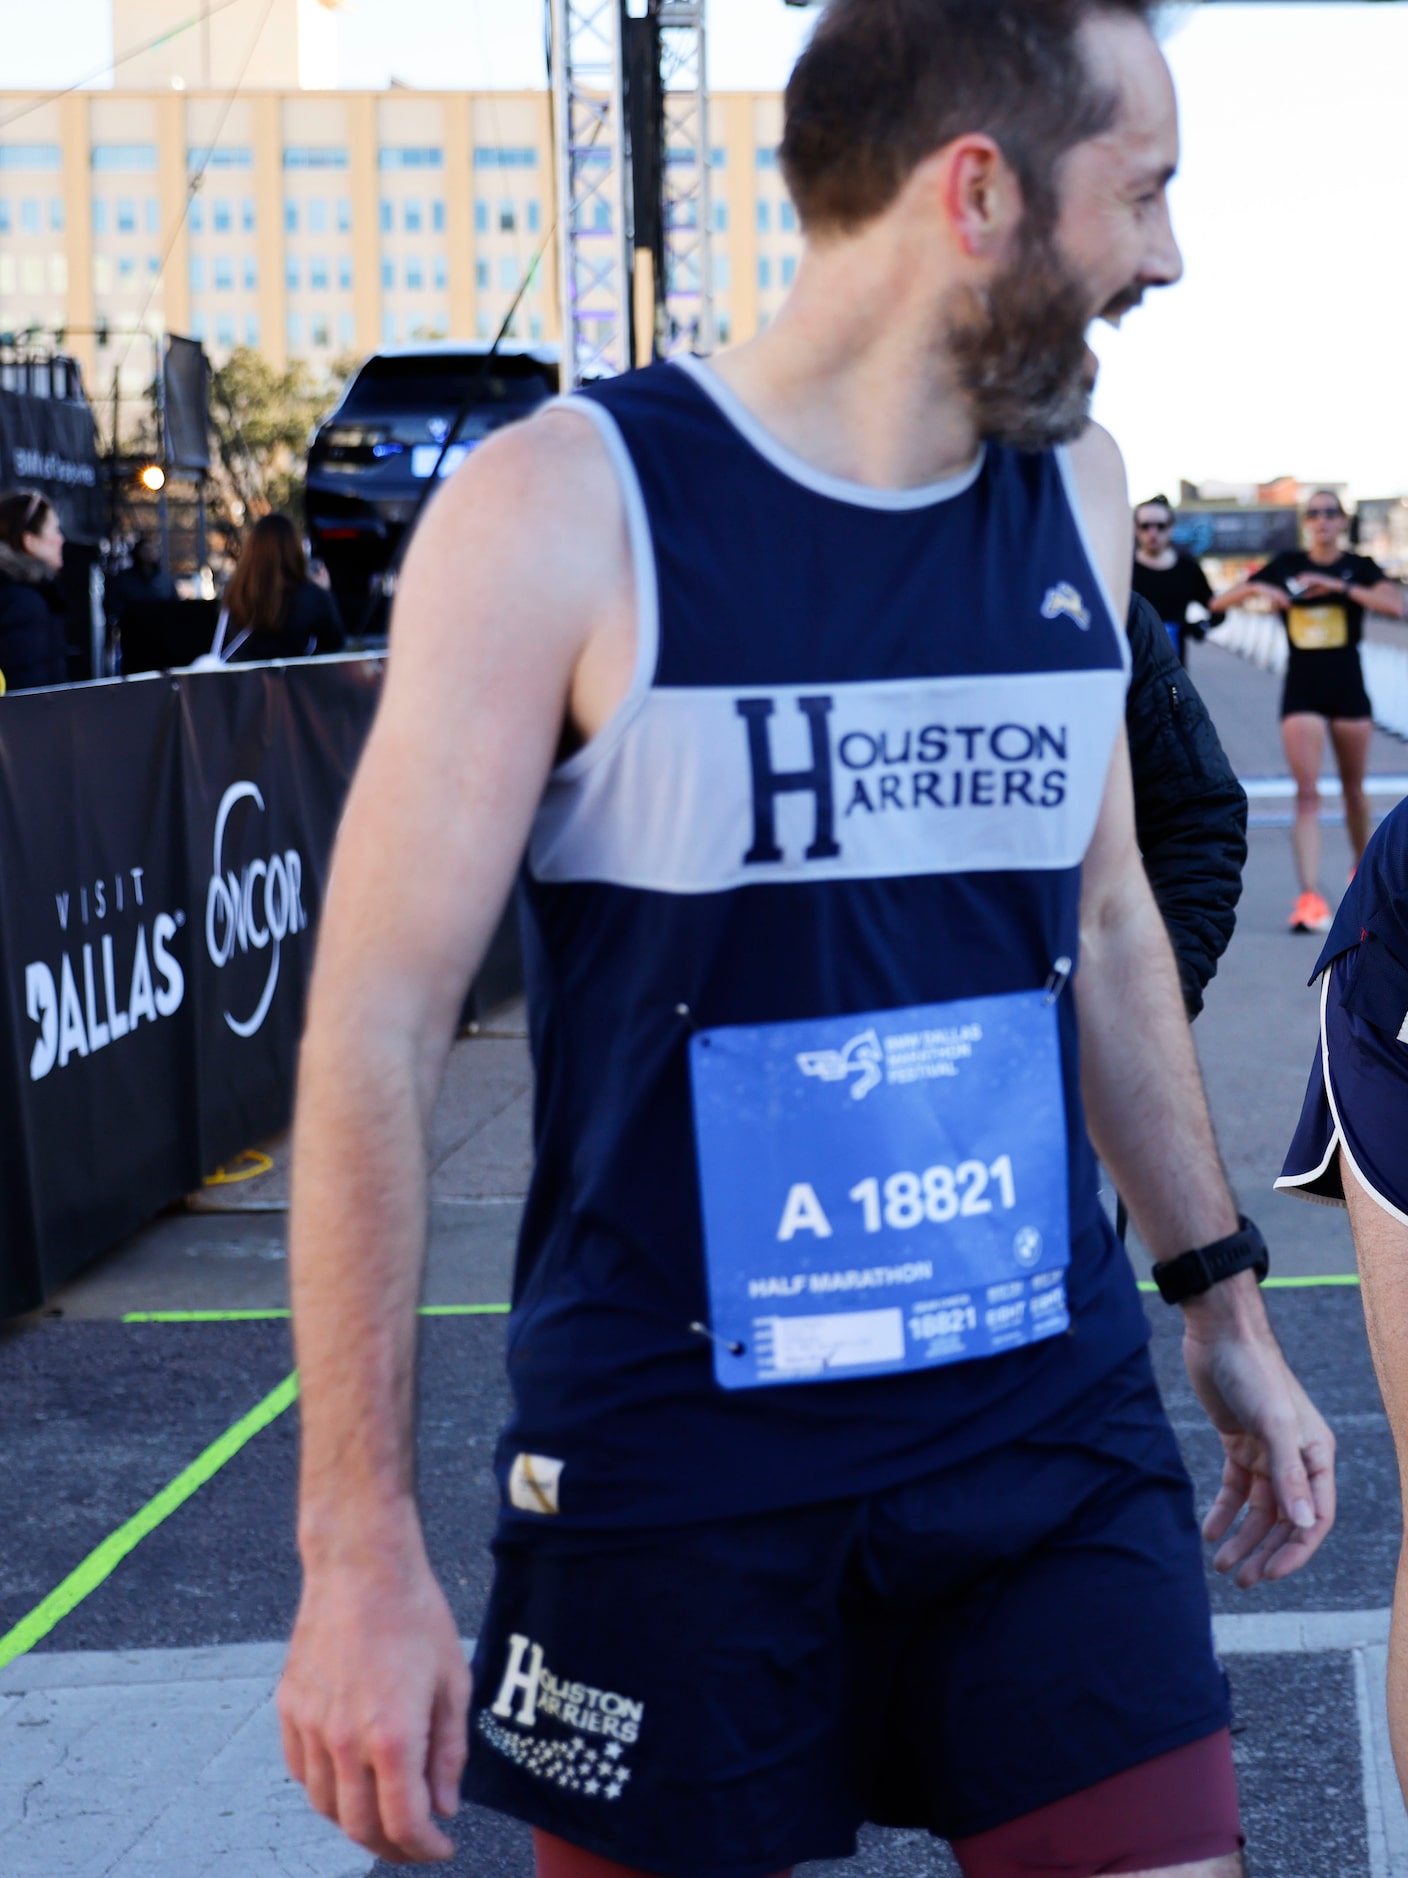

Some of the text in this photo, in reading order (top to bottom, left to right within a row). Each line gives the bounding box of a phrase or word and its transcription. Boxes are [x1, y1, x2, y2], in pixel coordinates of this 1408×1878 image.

[55, 866, 145, 932] VISIT
[25, 911, 185, 1082] DALLAS
[777, 1154, 1017, 1241] A 18821
[748, 1259, 934, 1299] HALF MARATHON
